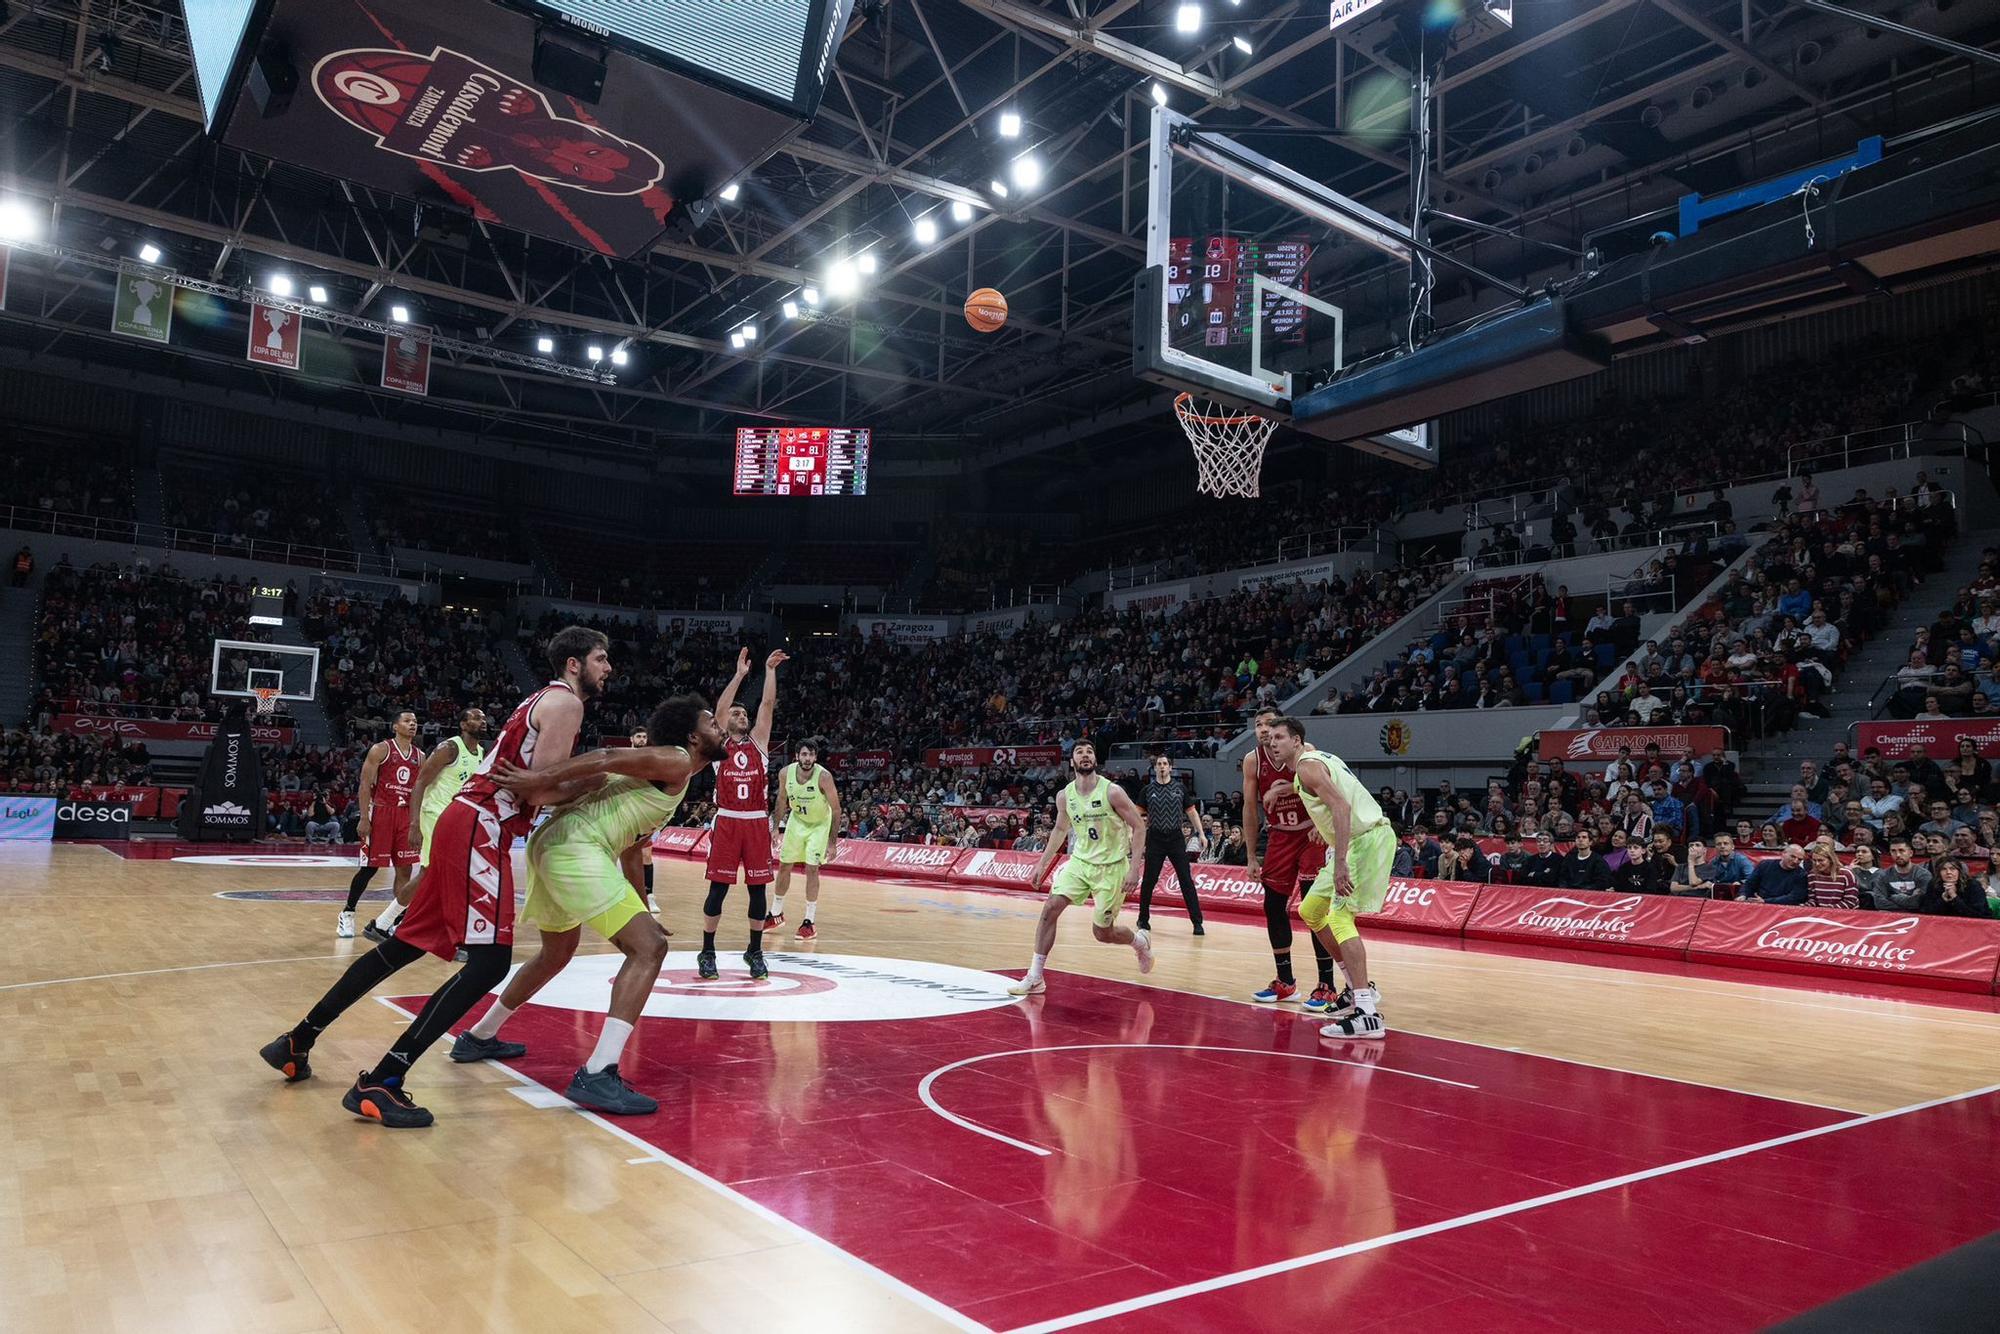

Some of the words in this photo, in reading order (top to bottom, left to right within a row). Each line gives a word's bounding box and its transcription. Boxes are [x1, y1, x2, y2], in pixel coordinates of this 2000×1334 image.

[571, 16, 610, 37] MONDO
[405, 85, 446, 128] ZARAGOZA
[419, 73, 501, 160] Casademont
[979, 308, 1005, 321] Wilson
[119, 321, 138, 329] COPA
[254, 346, 270, 356] COPA
[270, 348, 282, 358] DEL
[283, 350, 295, 360] REY
[386, 376, 402, 384] COPA
[261, 587, 283, 597] 3:17
[689, 618, 731, 630] Zaragoza
[891, 623, 934, 633] Zaragoza
[75, 718, 147, 734] aura
[1876, 735, 1936, 744] Chemieuro
[224, 739, 239, 788] SOMMOS
[737, 783, 749, 800] 0
[57, 802, 129, 823] desa
[205, 815, 249, 825] SOMMOS
[1276, 811, 1298, 826] 19
[1087, 827, 1099, 841] 8
[893, 847, 951, 866] AMBAR
[1518, 910, 1635, 933] Campodulce
[1559, 930, 1628, 941] CURADOS
[1757, 930, 1915, 961] Campodulce
[1815, 956, 1906, 971] CURADOS
